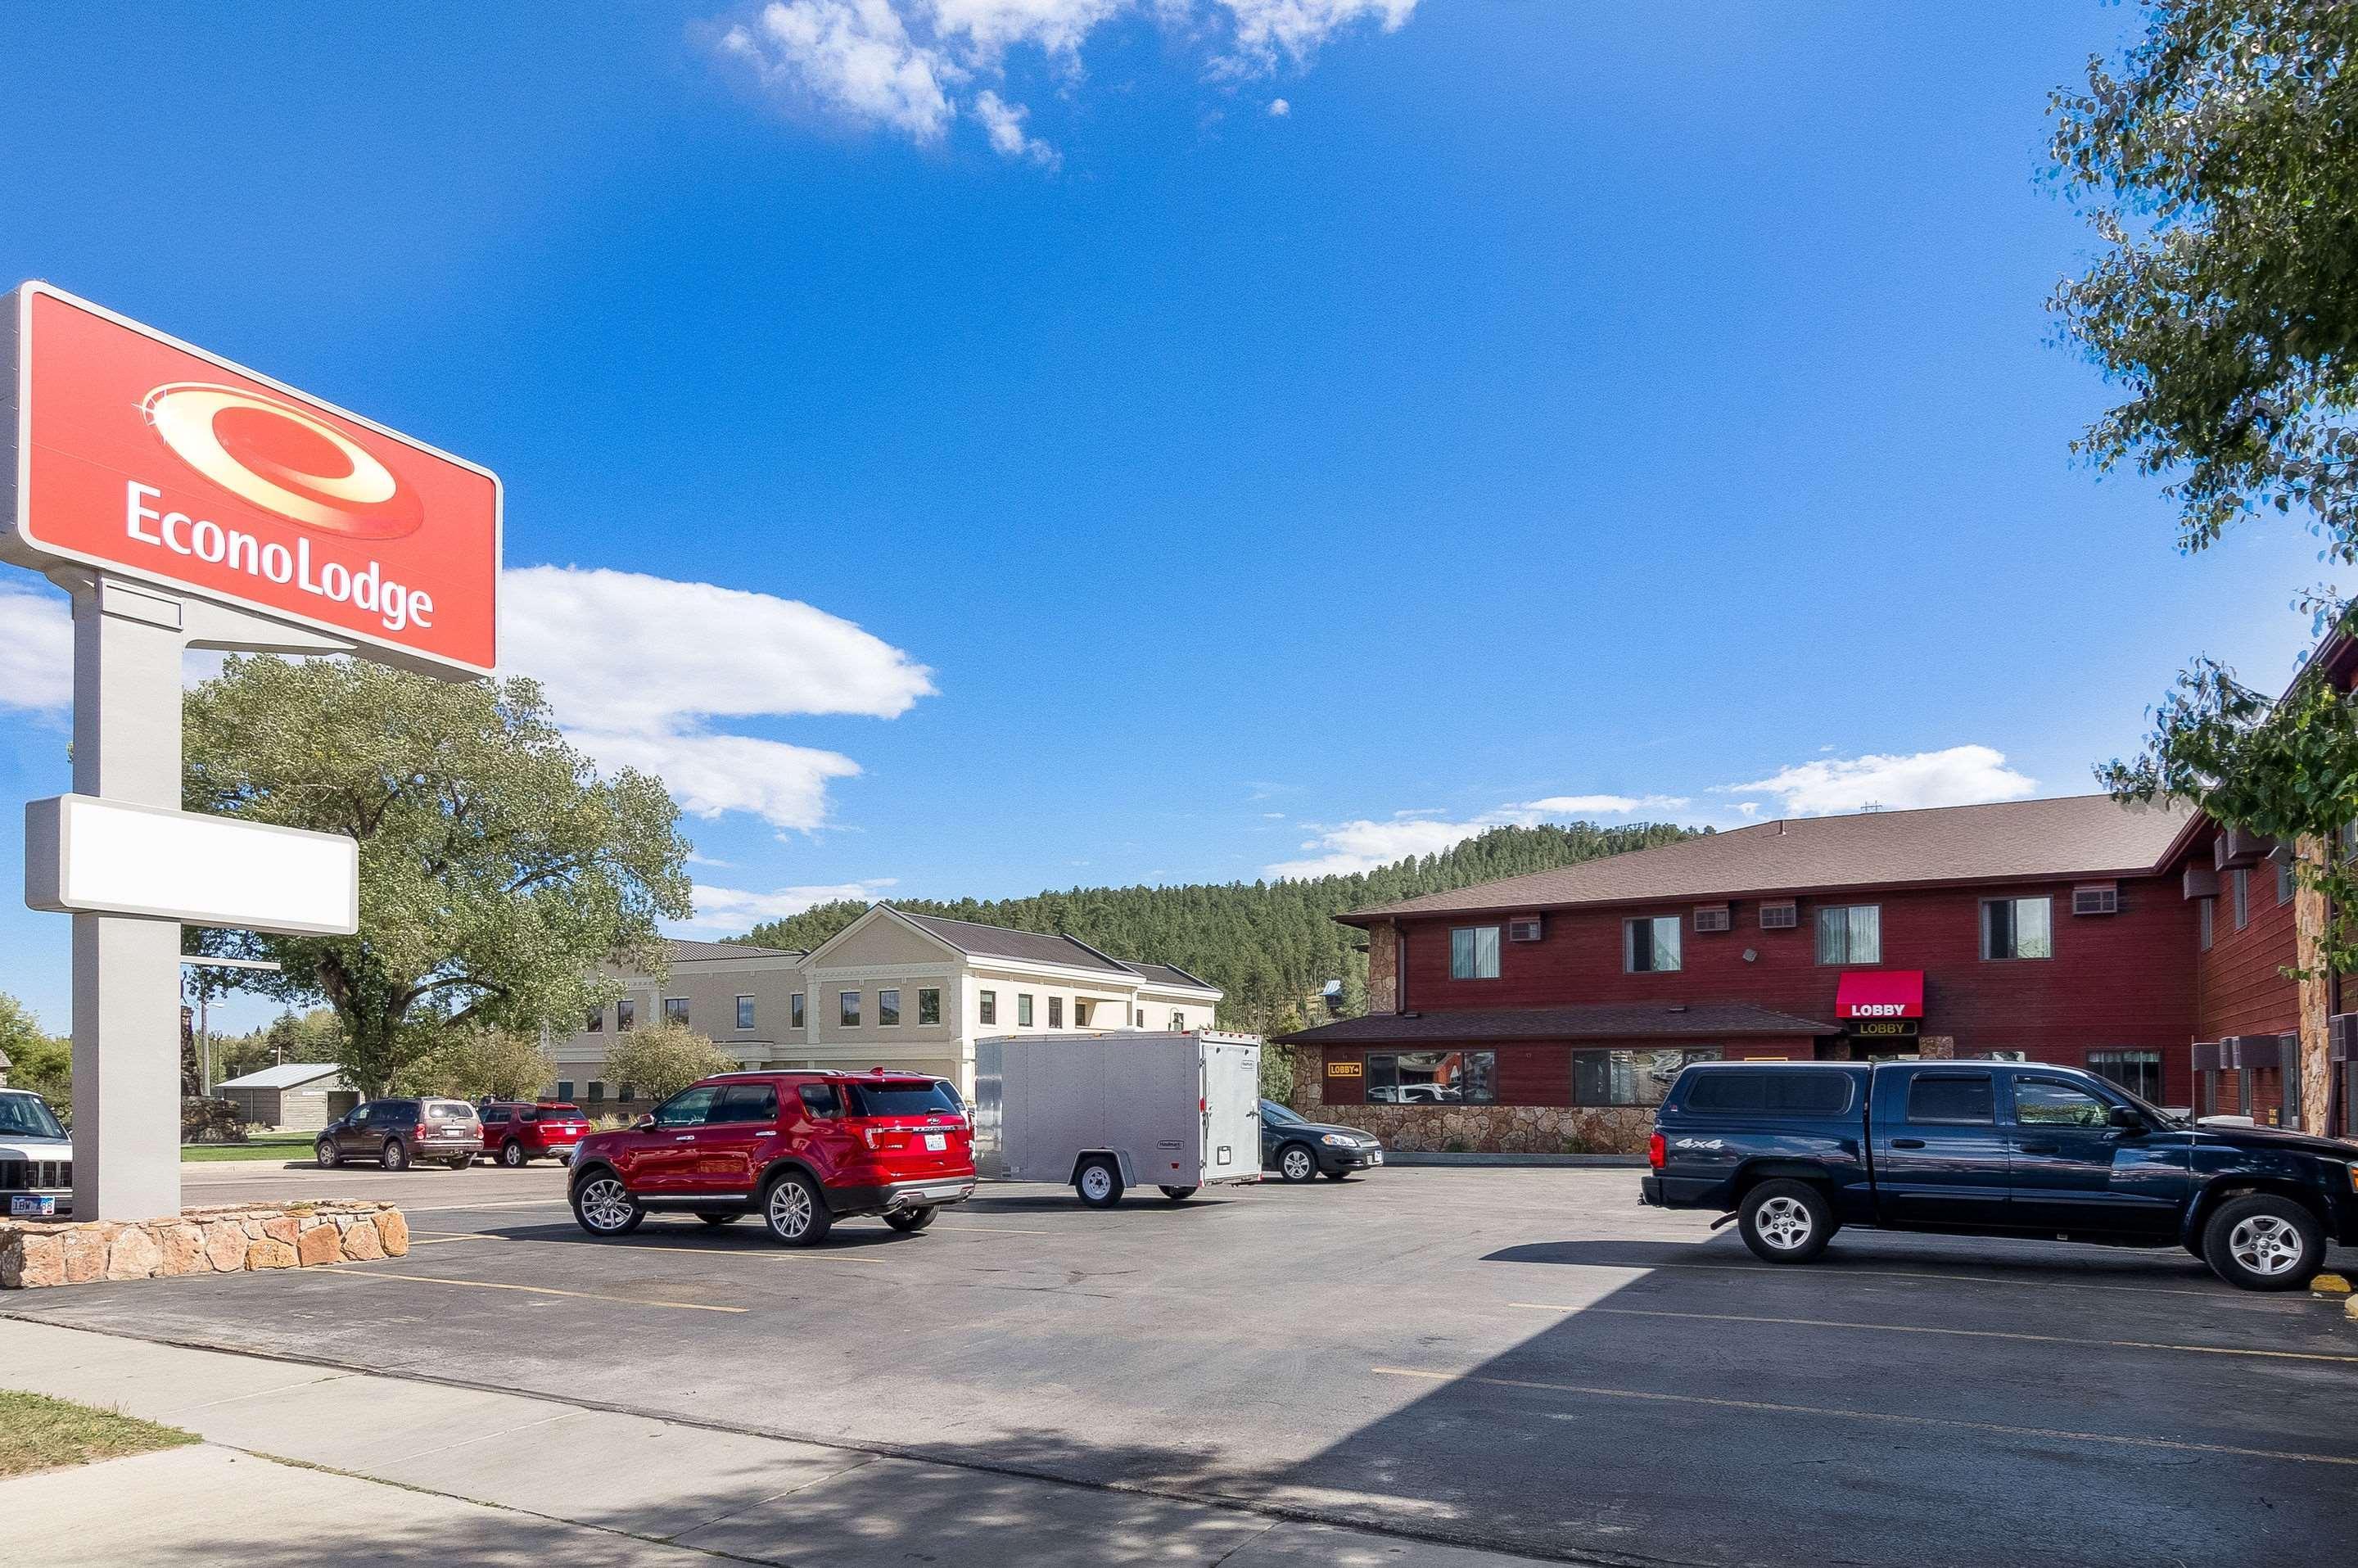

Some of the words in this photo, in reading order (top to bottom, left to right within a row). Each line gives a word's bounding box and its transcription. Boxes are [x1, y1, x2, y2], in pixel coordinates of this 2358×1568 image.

[126, 480, 435, 630] EconoLodge
[1851, 1004, 1905, 1016] LOBBY
[1859, 1023, 1905, 1034] LOBBY
[1330, 1065, 1355, 1074] LOBBY
[1675, 1138, 1725, 1150] 4x4
